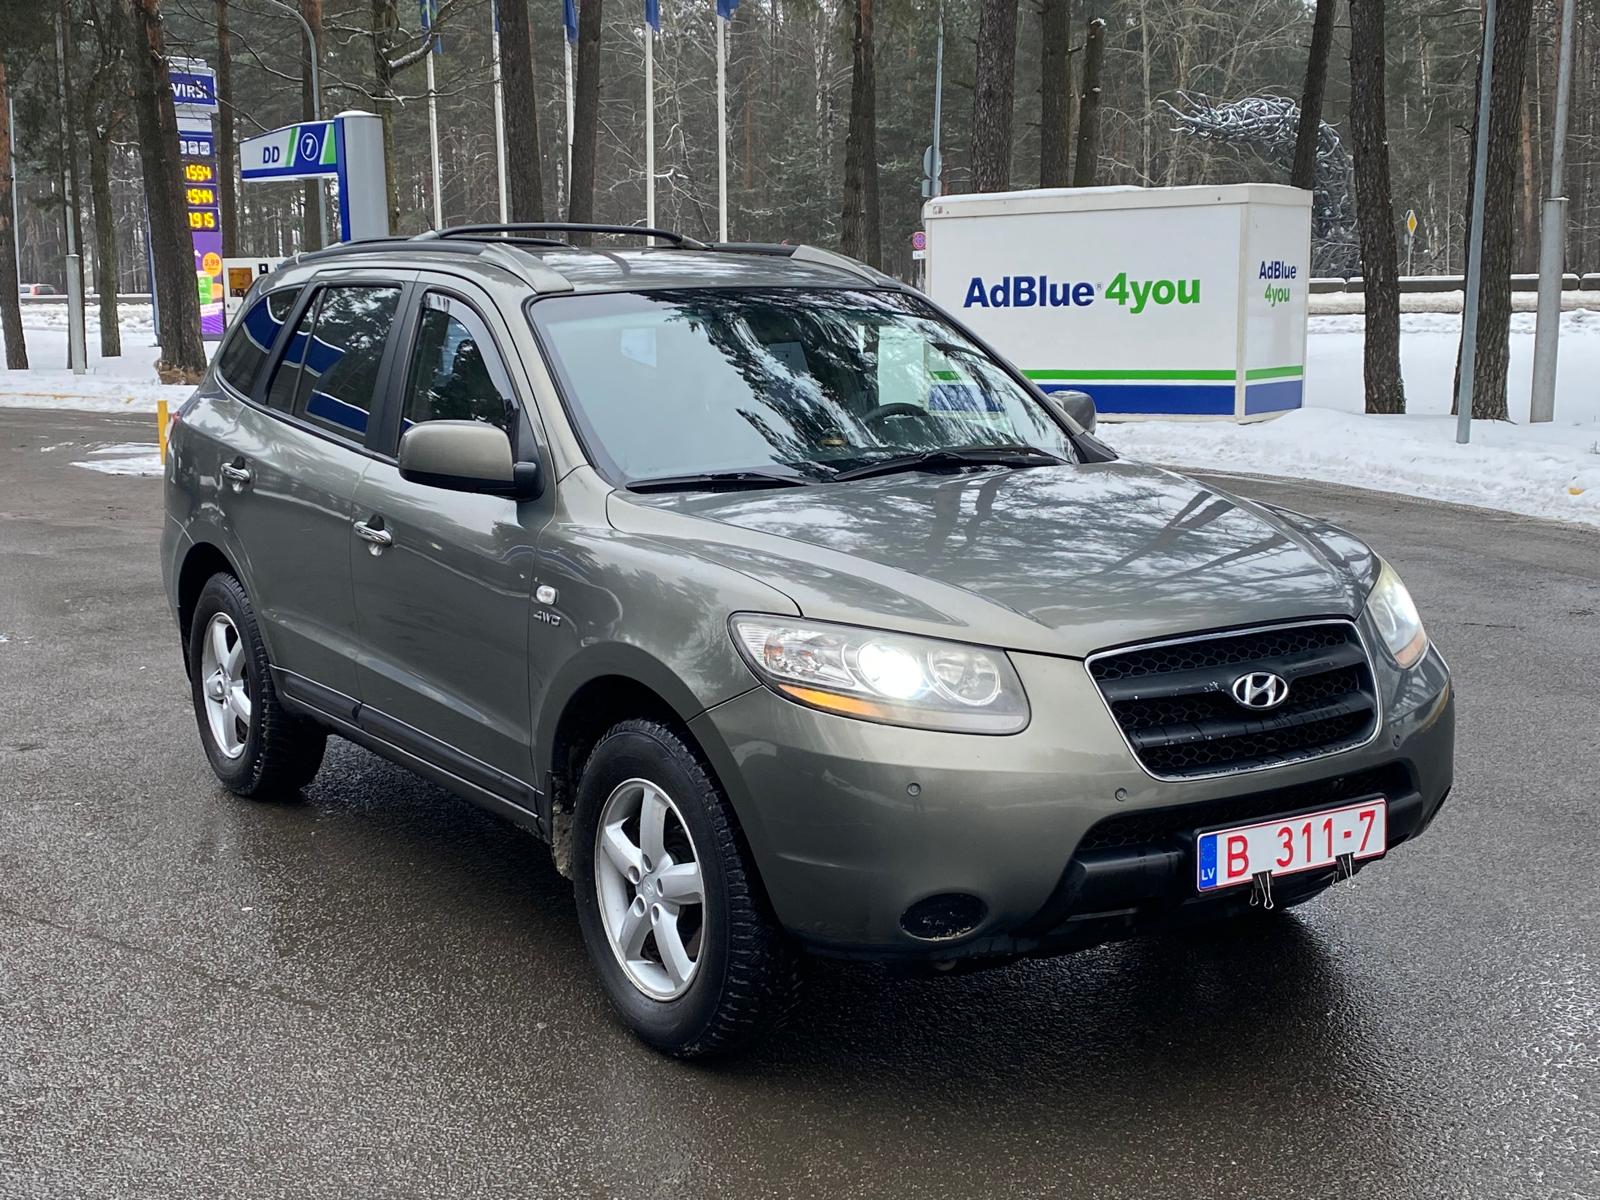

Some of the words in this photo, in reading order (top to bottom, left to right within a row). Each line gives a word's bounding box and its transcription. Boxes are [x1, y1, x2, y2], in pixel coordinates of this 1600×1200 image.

[263, 146, 280, 164] DD
[305, 138, 314, 155] 7
[1259, 260, 1297, 280] AdBlue
[1105, 272, 1200, 314] 4you
[1264, 283, 1291, 308] 4you
[533, 610, 561, 626] 4WD
[1201, 867, 1215, 881] LV
[1226, 835, 1249, 879] B
[1276, 809, 1376, 868] 311-7
